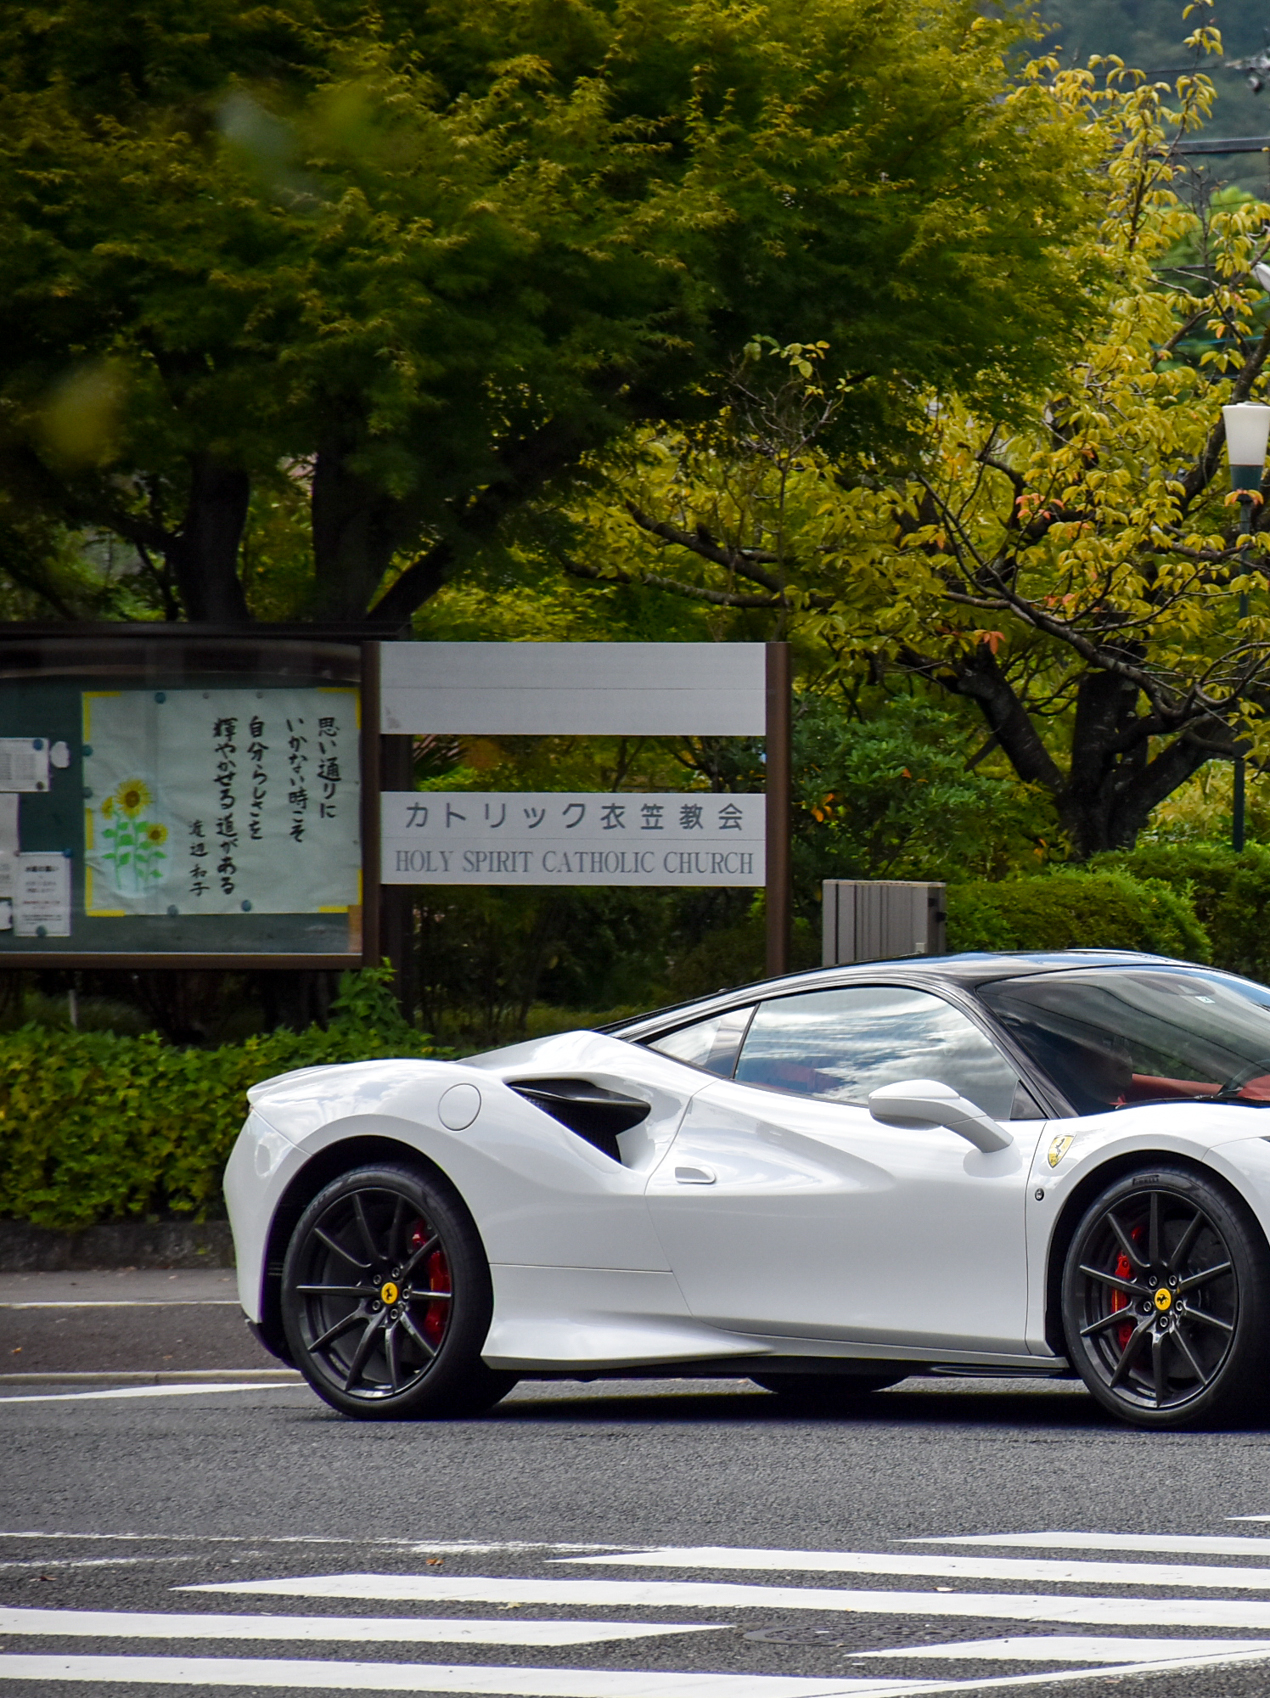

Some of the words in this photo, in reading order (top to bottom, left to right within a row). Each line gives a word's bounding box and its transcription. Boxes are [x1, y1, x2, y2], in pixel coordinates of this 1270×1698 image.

[287, 718, 308, 843] いかない時こそ
[317, 717, 341, 818] 思い通りに
[405, 803, 743, 830] カトリック衣笠教会
[396, 850, 453, 873] HOLY
[463, 851, 533, 873] SPIRIT
[542, 851, 655, 874] CATHOLIC
[663, 852, 753, 875] CHURCH
